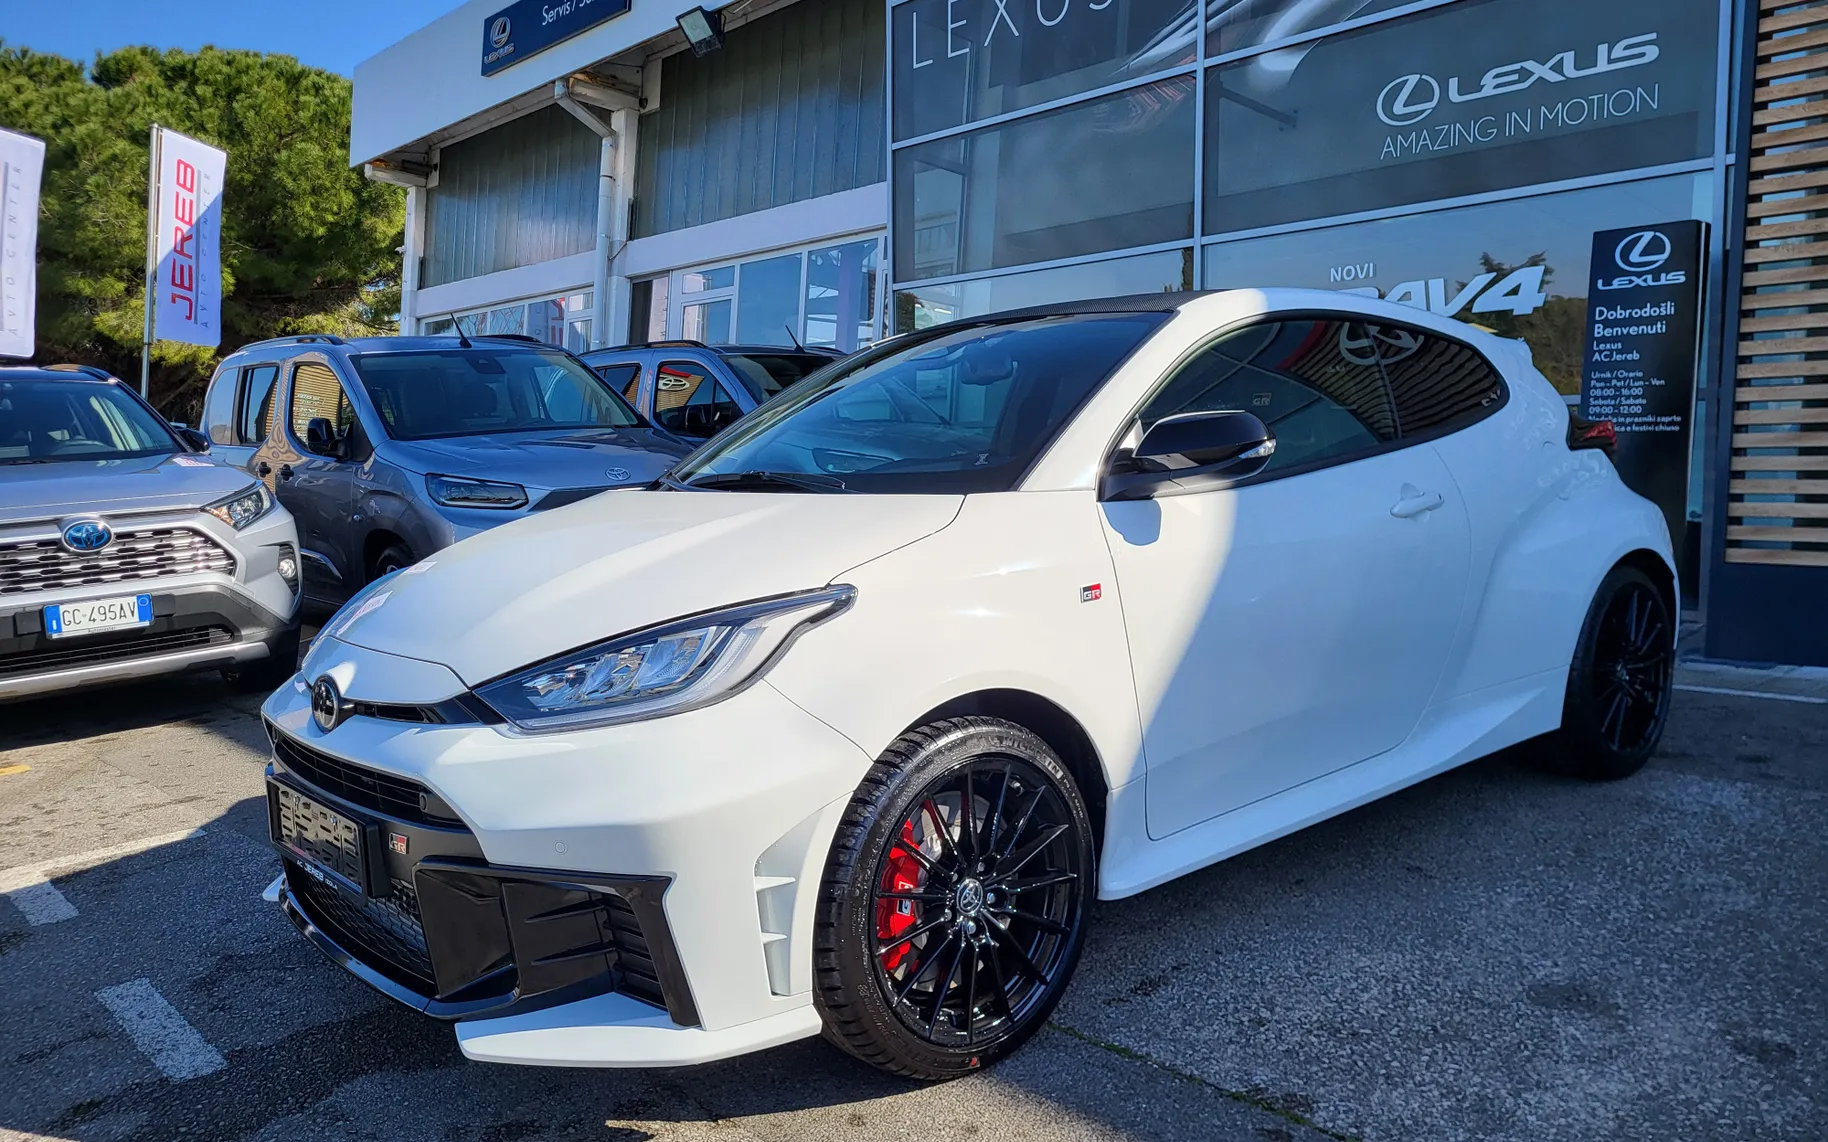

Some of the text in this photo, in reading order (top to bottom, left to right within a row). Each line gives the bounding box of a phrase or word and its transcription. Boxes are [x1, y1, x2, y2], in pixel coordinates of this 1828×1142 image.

[542, 0, 571, 26] Servis
[913, 0, 1112, 69] LEX
[484, 43, 515, 64] LEXUS
[1449, 32, 1660, 103] LEXUS
[1380, 83, 1659, 160] AMAZING IN MOTION
[171, 158, 195, 321] JEREB
[1330, 262, 1374, 283] NOVI
[1597, 271, 1686, 290] LEXUS
[1336, 265, 1547, 317] AV4
[1595, 301, 1675, 320] Dobrodošli
[1594, 320, 1666, 337] Benvenuti
[1593, 340, 1622, 351] Lexus
[1617, 370, 1644, 378] Orario
[1630, 378, 1644, 387] Lun
[1650, 378, 1666, 386] Ven
[1589, 388, 1615, 397] 08:00
[1621, 387, 1643, 396] 16:00
[1621, 397, 1647, 405] Sabato
[1588, 406, 1614, 414] 09:00
[1620, 405, 1642, 414] 12:00
